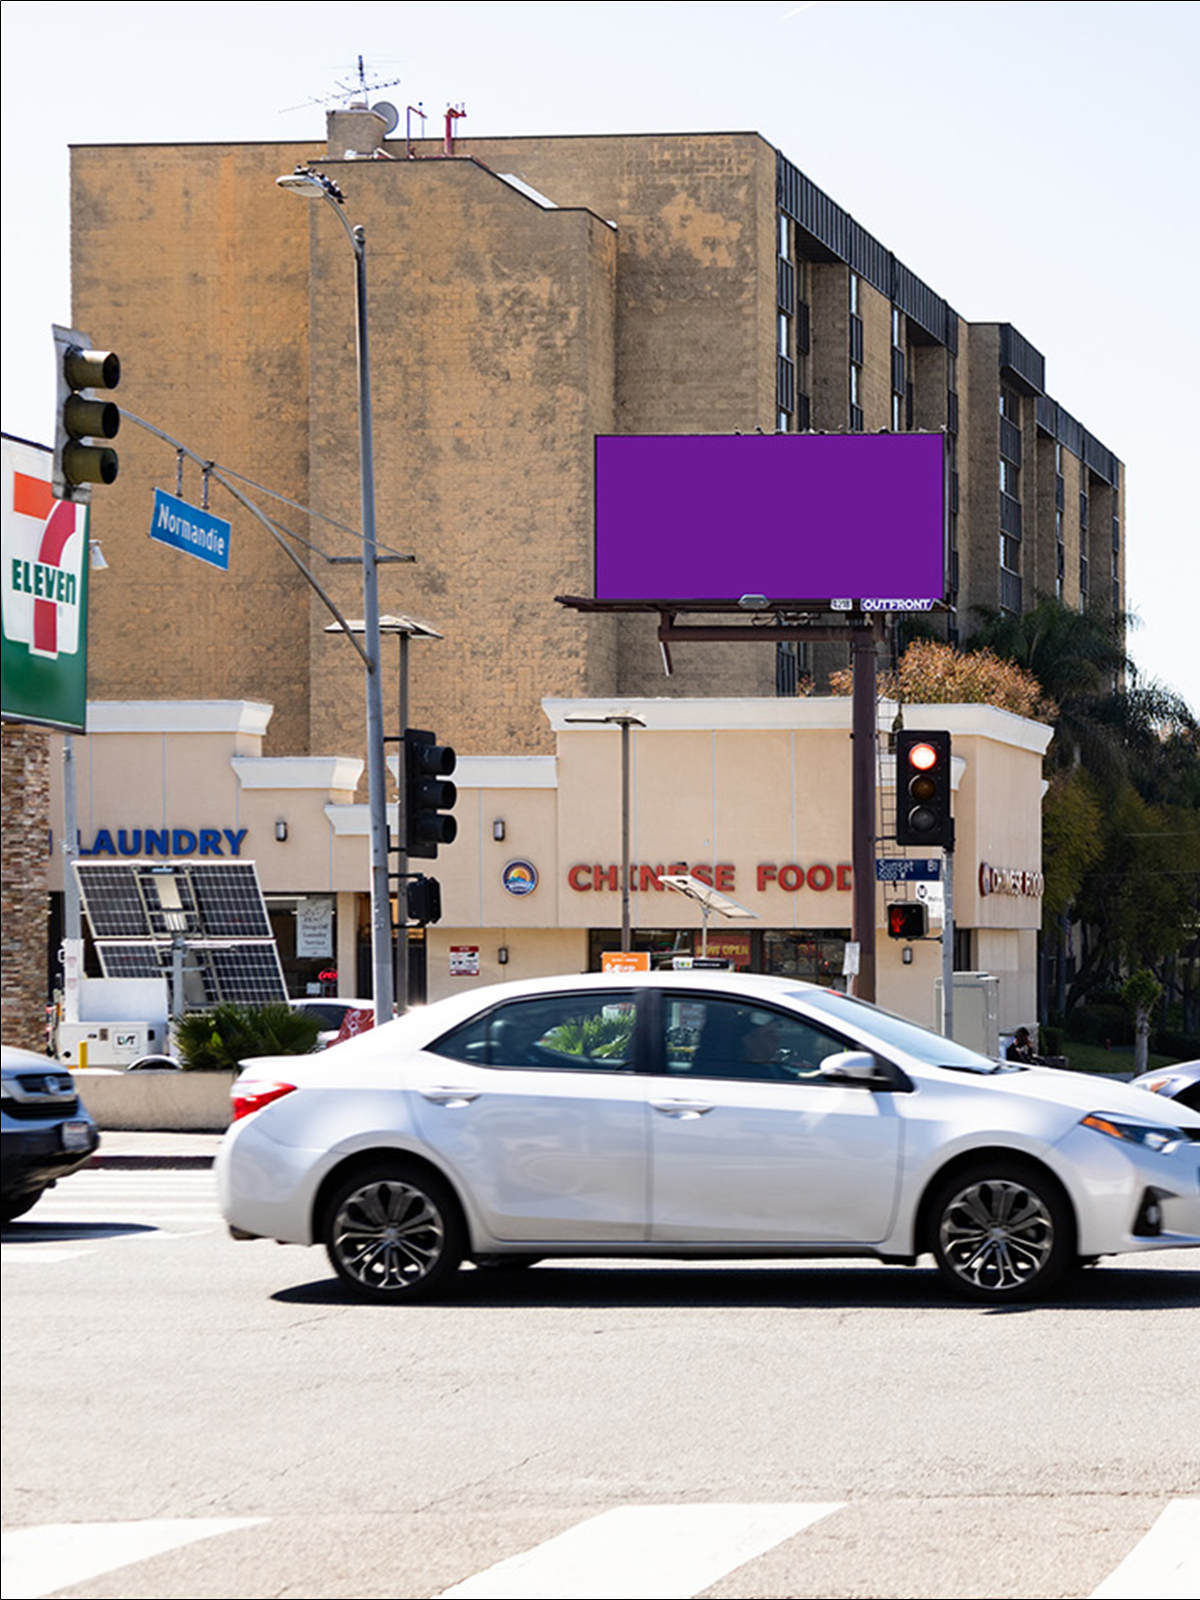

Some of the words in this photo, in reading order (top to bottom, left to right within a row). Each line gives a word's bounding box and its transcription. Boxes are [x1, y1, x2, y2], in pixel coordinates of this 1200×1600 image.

[157, 503, 225, 556] Normandie
[863, 599, 932, 611] OUTFRONT
[77, 829, 248, 856] LAUNDRY
[878, 860, 914, 872] Sunset
[756, 864, 852, 892] FOOD
[722, 943, 749, 957] OPEN
